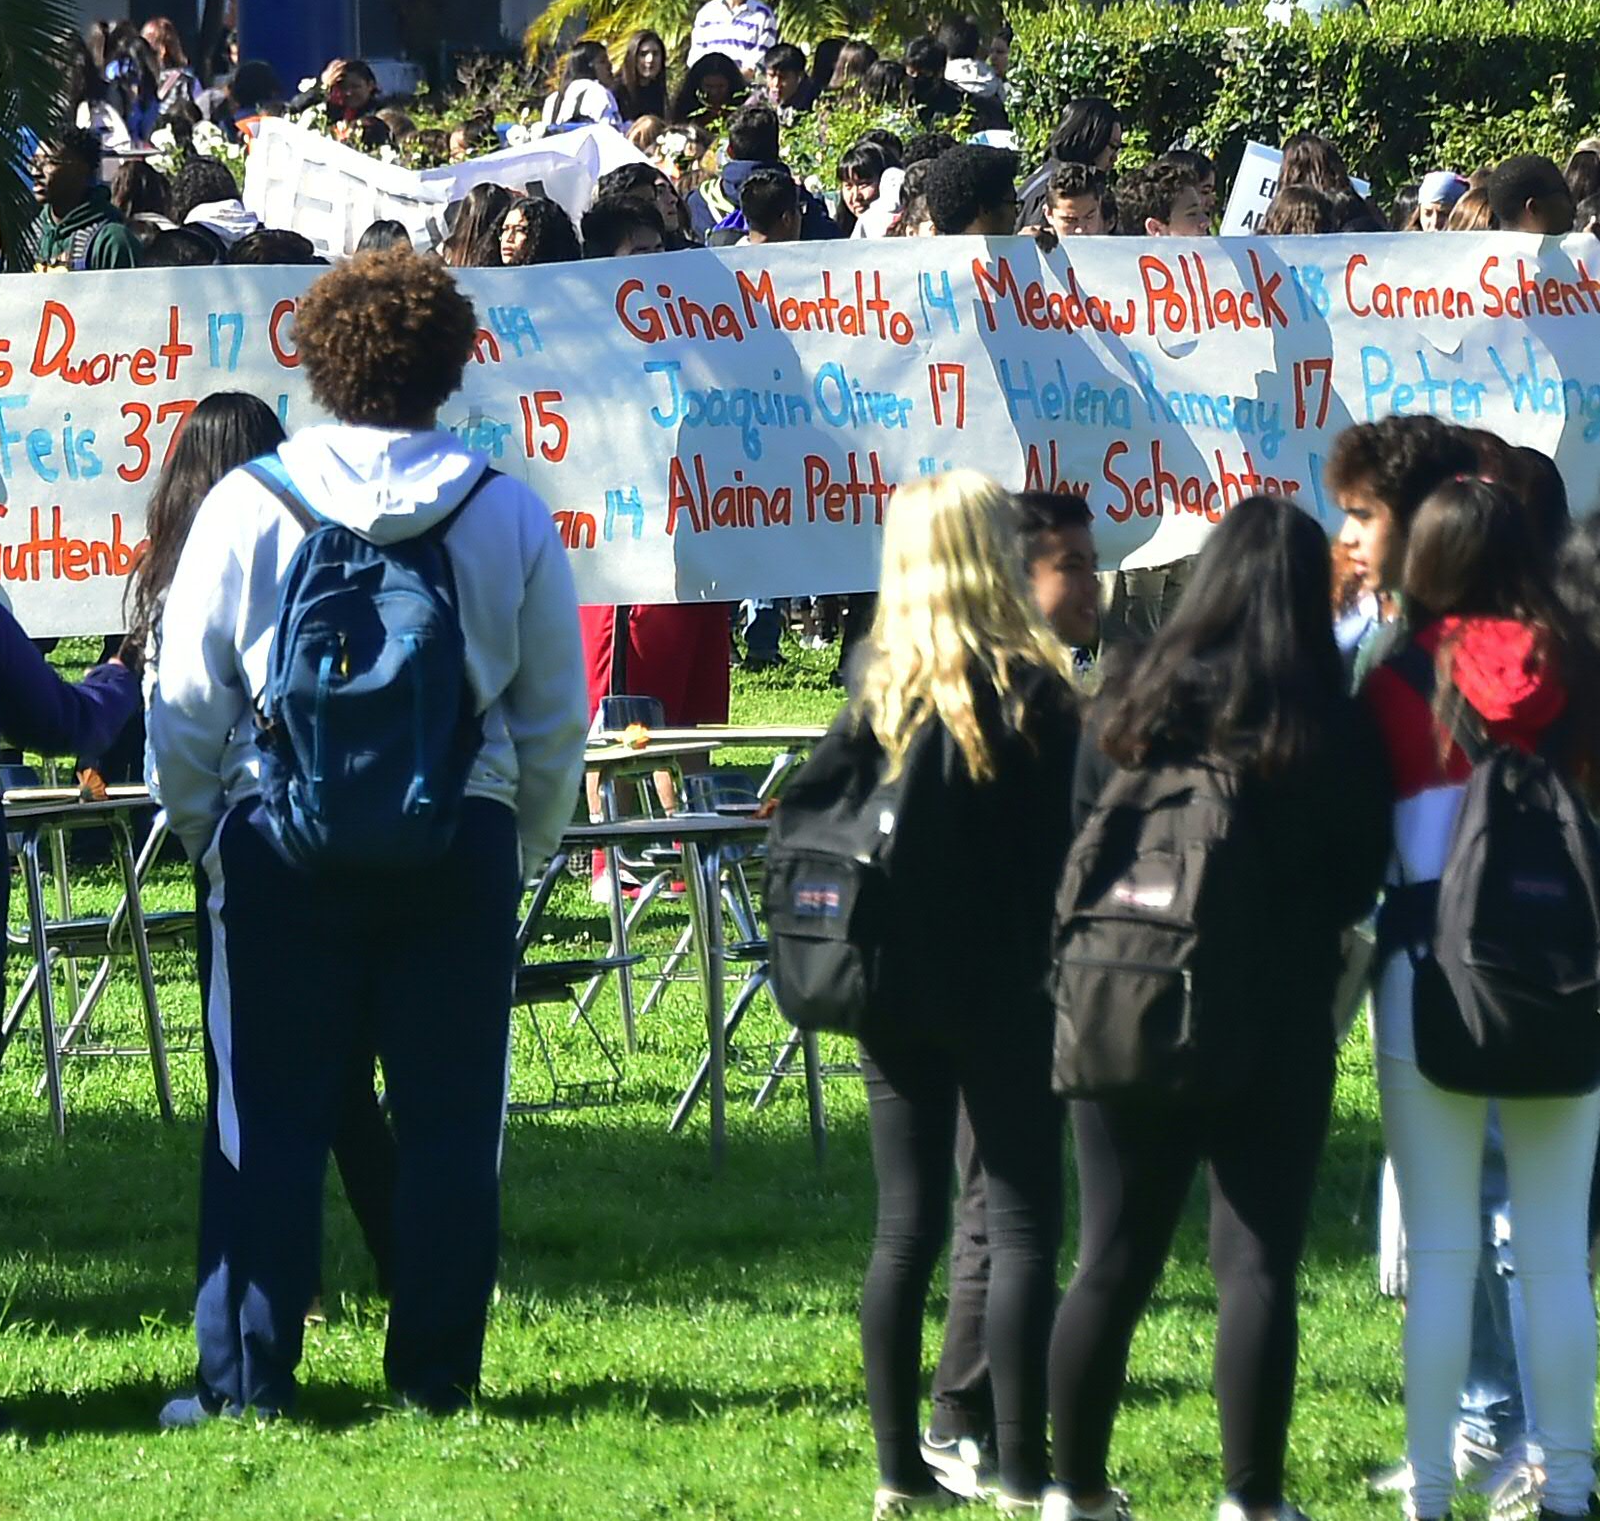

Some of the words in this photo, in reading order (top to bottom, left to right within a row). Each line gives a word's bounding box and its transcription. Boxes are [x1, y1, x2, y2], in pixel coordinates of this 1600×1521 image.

[30, 300, 193, 385] Dworet
[208, 312, 244, 373] 17
[615, 279, 744, 343] Gina
[735, 270, 913, 345] Montalto
[918, 270, 960, 333] 14
[972, 257, 1135, 336] Meadow
[1139, 251, 1288, 336] Pollack
[1289, 264, 1330, 321] 18
[1345, 254, 1474, 319] Carmen
[117, 399, 198, 482] 37
[519, 391, 569, 462] 15
[643, 361, 812, 461] Joaquin
[813, 362, 913, 429] Oliver
[928, 363, 964, 429] 17
[1000, 358, 1132, 429] Helena
[1128, 350, 1286, 460] Ramsay
[1293, 357, 1332, 429] 17
[1360, 345, 1487, 422] Peter
[604, 486, 645, 541] 14
[665, 453, 791, 536] Alaina
[804, 451, 897, 526] Pett
